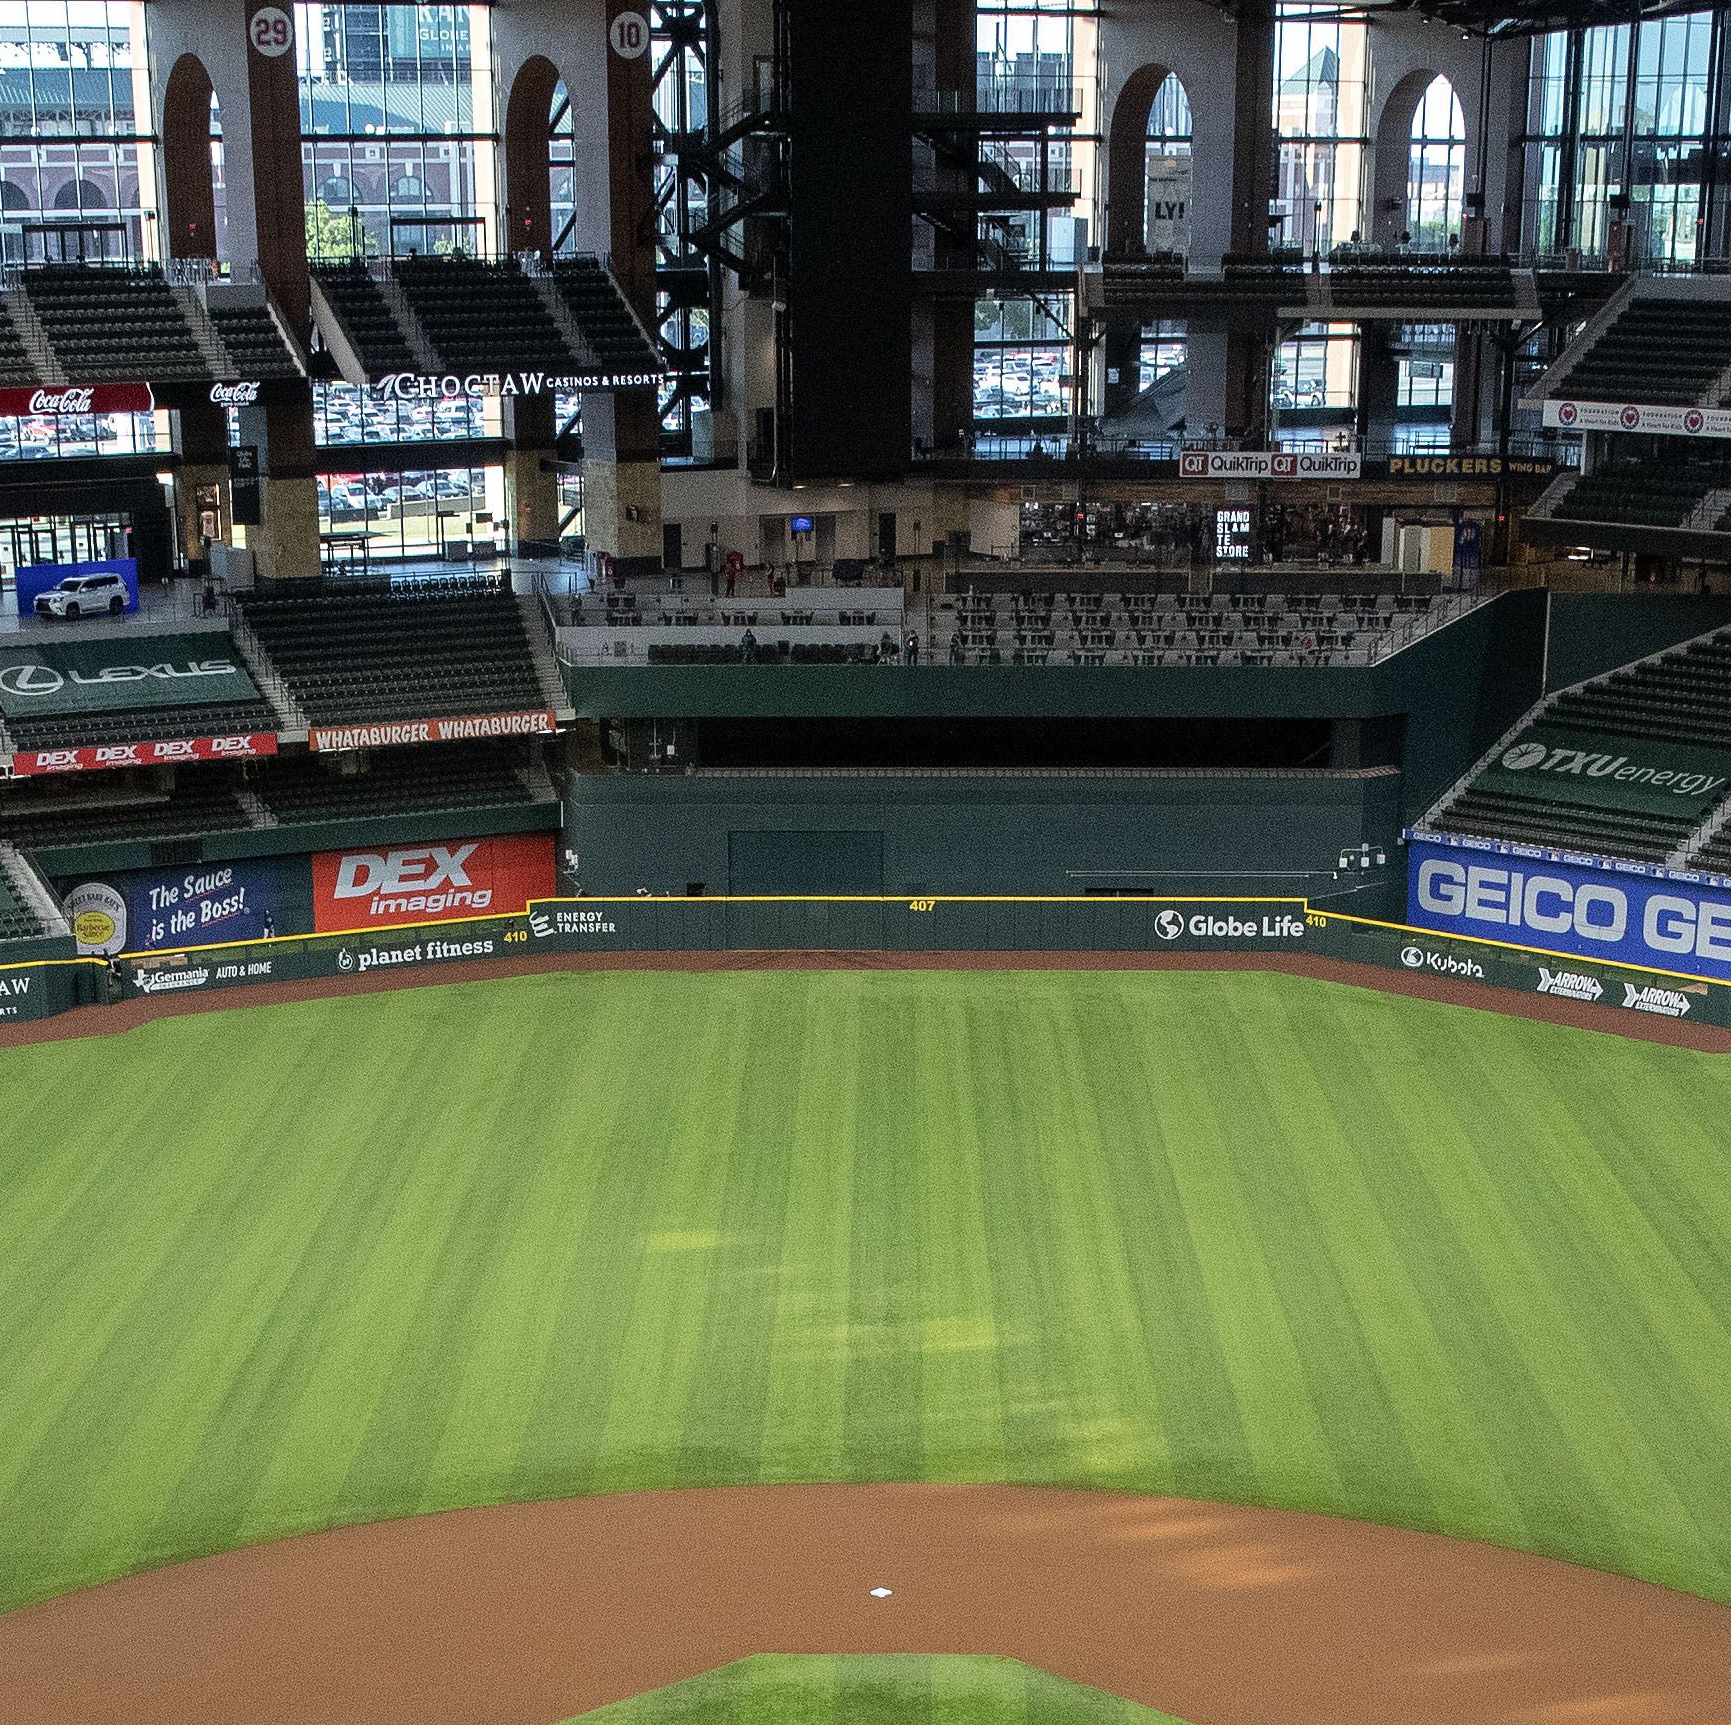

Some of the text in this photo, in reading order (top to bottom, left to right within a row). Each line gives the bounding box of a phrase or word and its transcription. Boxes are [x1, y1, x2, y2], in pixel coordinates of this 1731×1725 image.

[255, 18, 288, 46] 29
[620, 21, 641, 48] 10
[210, 382, 261, 402] Coca-Cola
[395, 373, 664, 398] CHOCTAW CASINOS RESORTS
[29, 389, 95, 414] Coca-Cola
[1184, 456, 1269, 475] QT QuikTrip
[1273, 456, 1358, 475] QT QuikTrip
[1390, 458, 1501, 474] PLUCKERS
[1217, 511, 1250, 521] GRAND
[1216, 546, 1249, 558] STORE
[68, 660, 237, 685] LEXUS
[438, 712, 549, 739] WHATABURGER
[211, 735, 254, 752] DEX
[316, 723, 430, 749] WHATABURGER
[36, 749, 79, 766] DEX
[95, 744, 139, 761] DEX
[153, 740, 195, 756] DEX
[1614, 761, 1726, 798] energy
[1413, 831, 1441, 843] GEICO
[1463, 838, 1491, 850] GEICO
[1513, 846, 1541, 858] GEICO
[1563, 854, 1592, 866] GEICO
[334, 844, 478, 900] DEX
[1615, 862, 1645, 874] GEICO
[1669, 870, 1699, 883] GEICO
[149, 868, 233, 911] The Sauce
[369, 887, 493, 917] imaging
[909, 900, 936, 912] 407
[1417, 859, 1628, 942] GEICO
[151, 887, 245, 941] is the Boss!
[556, 911, 604, 923] ENERGY
[1305, 915, 1327, 928] 410
[556, 921, 617, 933] TRANSFER
[1189, 915, 1304, 938] Globe Life
[503, 931, 528, 944] 410
[358, 937, 494, 972] planet fitness
[1426, 950, 1484, 978] Kubota
[155, 961, 272, 984] Germania AUTO & HOME
[1550, 970, 1594, 991] ARROW
[1637, 987, 1682, 1007] ARROW
